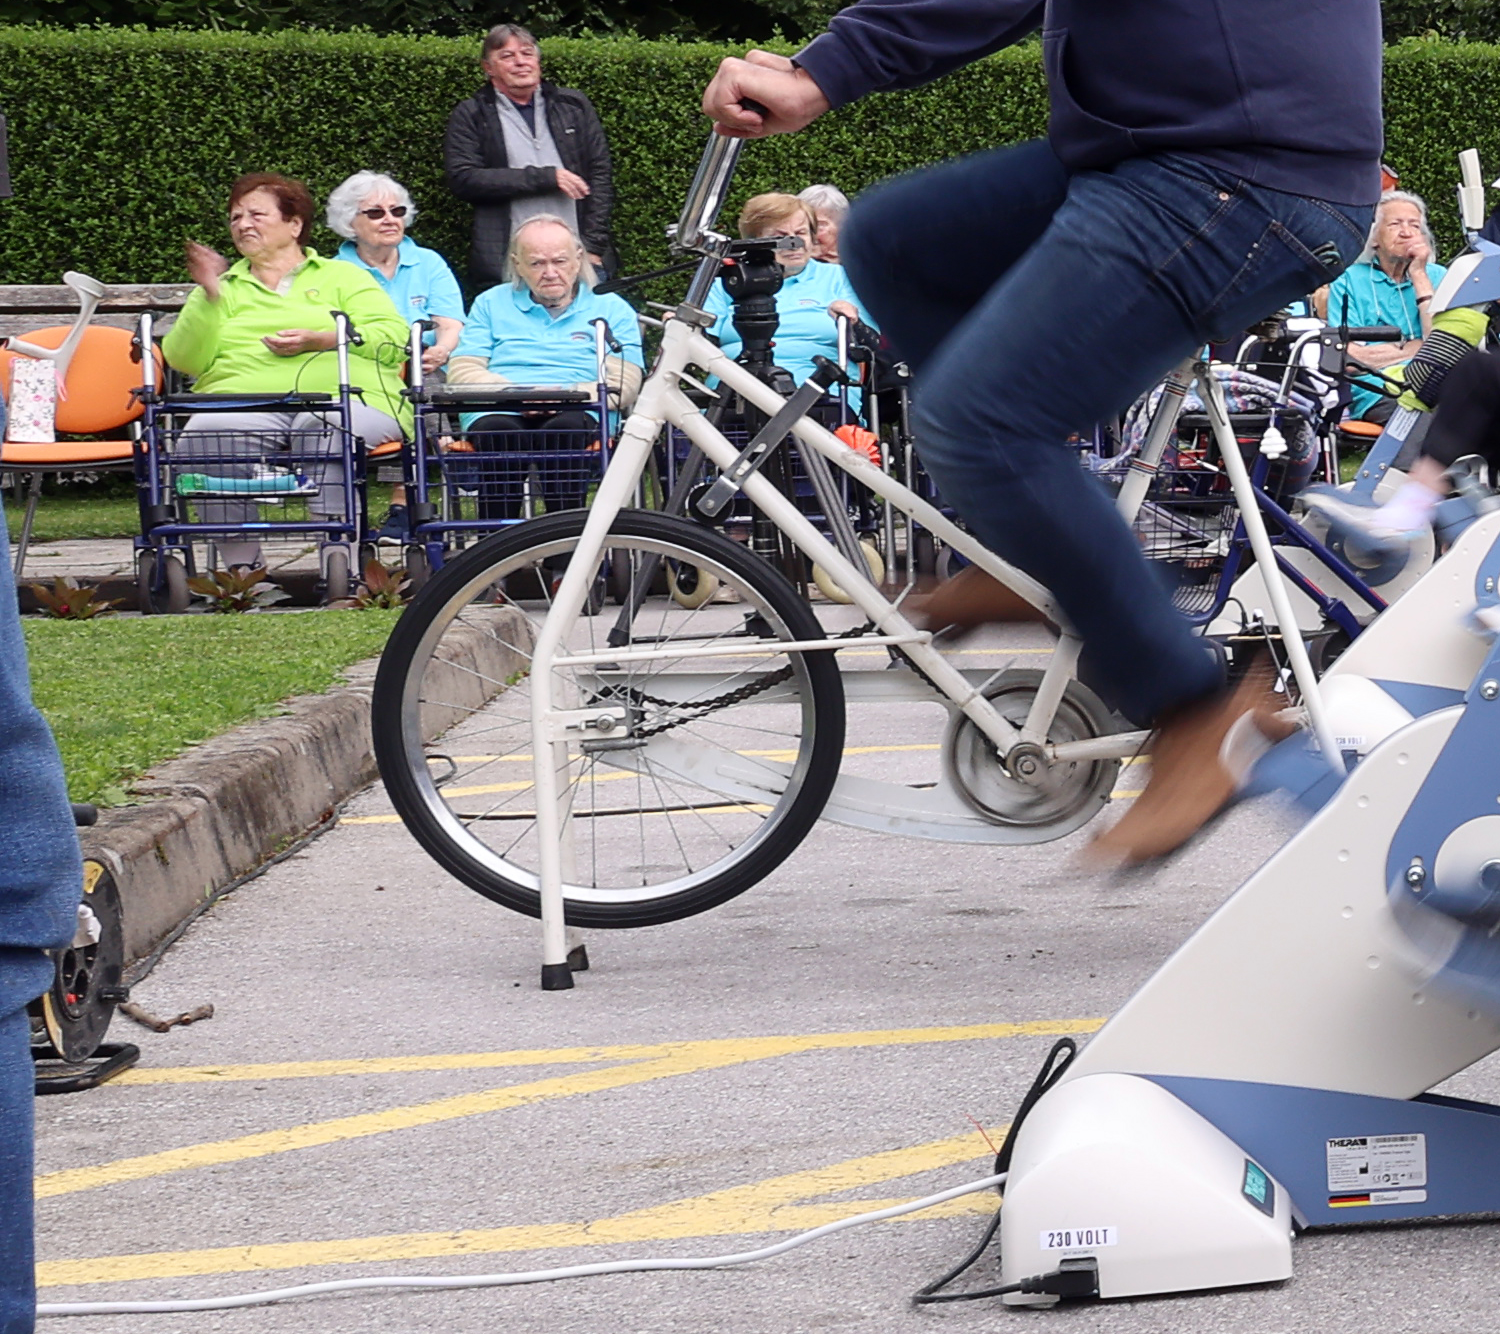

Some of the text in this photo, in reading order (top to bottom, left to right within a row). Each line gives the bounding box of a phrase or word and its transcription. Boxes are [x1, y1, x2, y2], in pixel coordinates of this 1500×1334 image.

[1328, 1138, 1359, 1147] THERA
[1048, 1228, 1108, 1248] 230 VOLT
